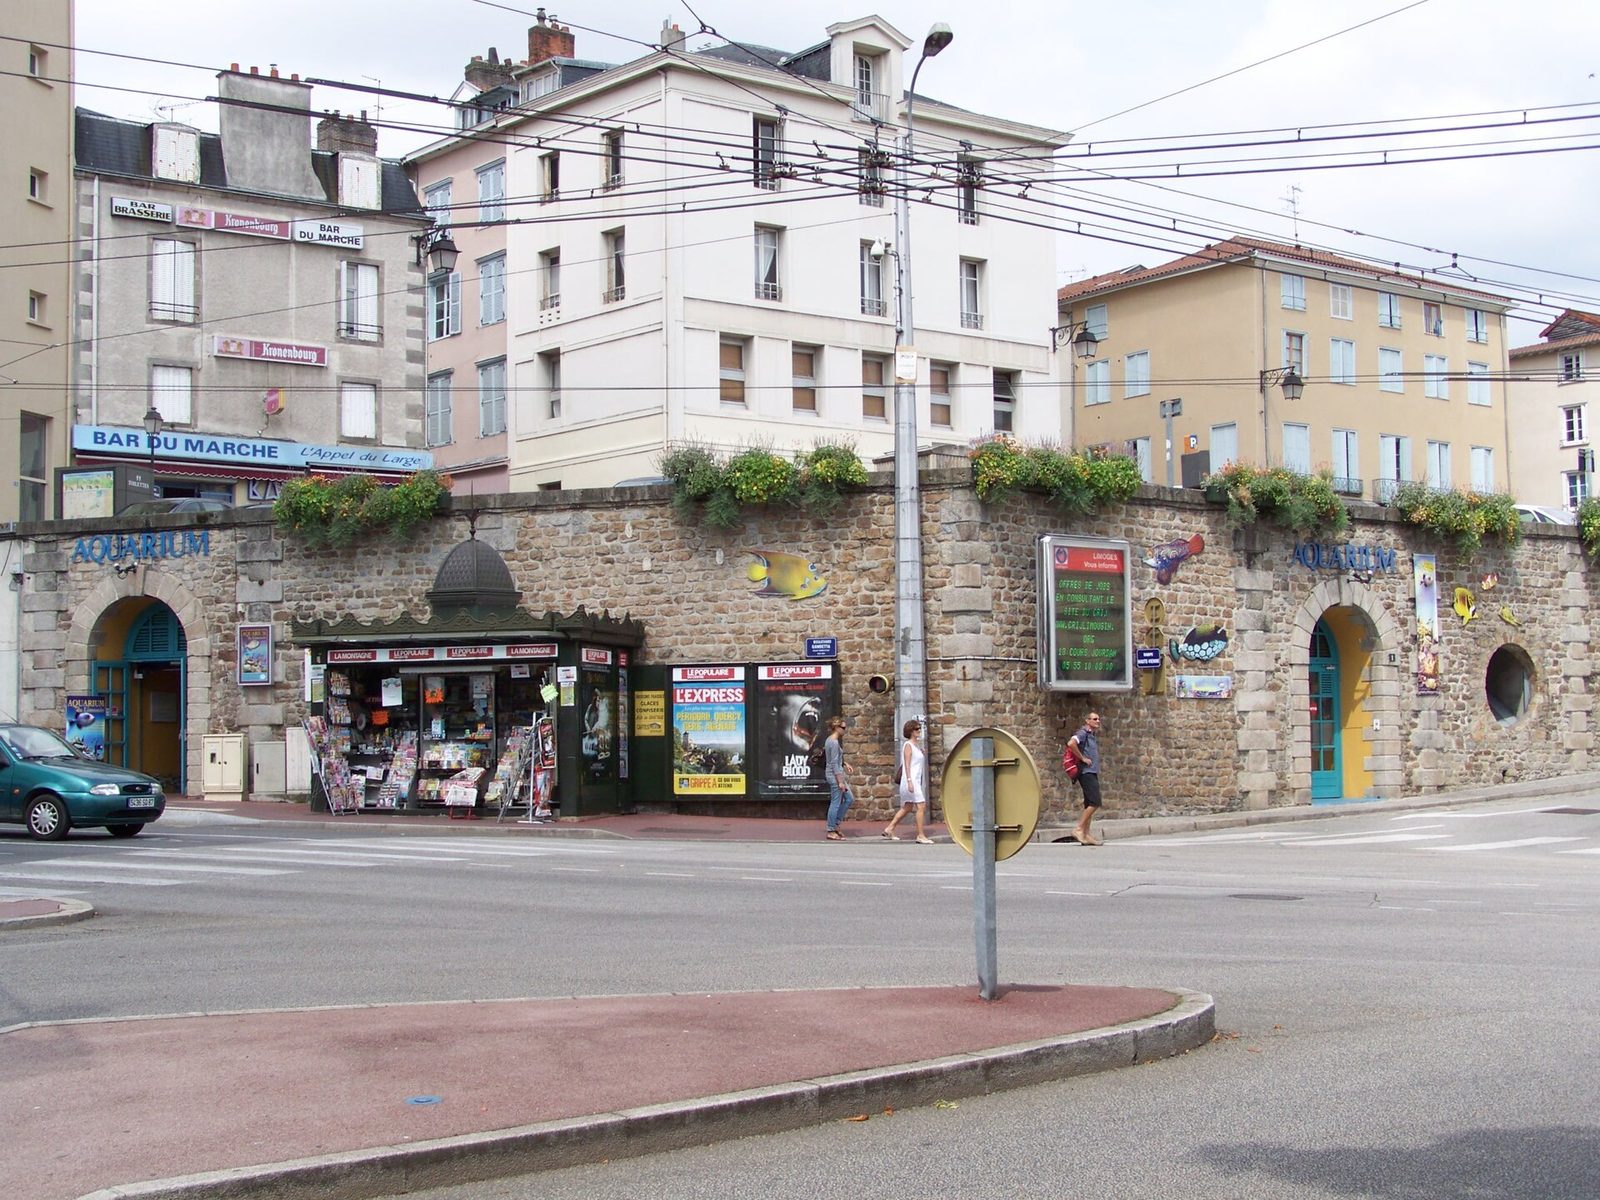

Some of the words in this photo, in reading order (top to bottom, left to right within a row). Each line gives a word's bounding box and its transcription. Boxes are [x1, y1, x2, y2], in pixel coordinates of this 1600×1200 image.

[130, 201, 156, 211] BAR
[114, 206, 172, 220] BRASSERIE
[225, 214, 279, 235] Kronenbourg
[320, 224, 340, 234] BAR
[300, 231, 314, 240] DU
[318, 232, 361, 246] MARCHE
[262, 343, 318, 362] Kronenbourg
[93, 431, 139, 448] BAR
[147, 435, 178, 450] DU
[184, 438, 278, 458] MARCHE
[1190, 437, 1197, 448] P
[300, 446, 353, 461] L'Appel
[360, 452, 378, 462] du
[382, 454, 422, 467] Large
[71, 529, 210, 564] AQUARIUM
[1290, 542, 1397, 572] AQUARIUM
[1107, 596, 1114, 604] LE
[1064, 608, 1078, 616] SITE
[781, 666, 816, 674] POPULAIRE
[1073, 662, 1081, 670] 55
[694, 668, 728, 676] POPULAIRE
[676, 688, 744, 702] L'EXPRESS
[785, 754, 808, 766] LADY
[782, 766, 810, 776] BLOOD
[690, 778, 711, 788] GRIPPE
[712, 778, 717, 788] A
